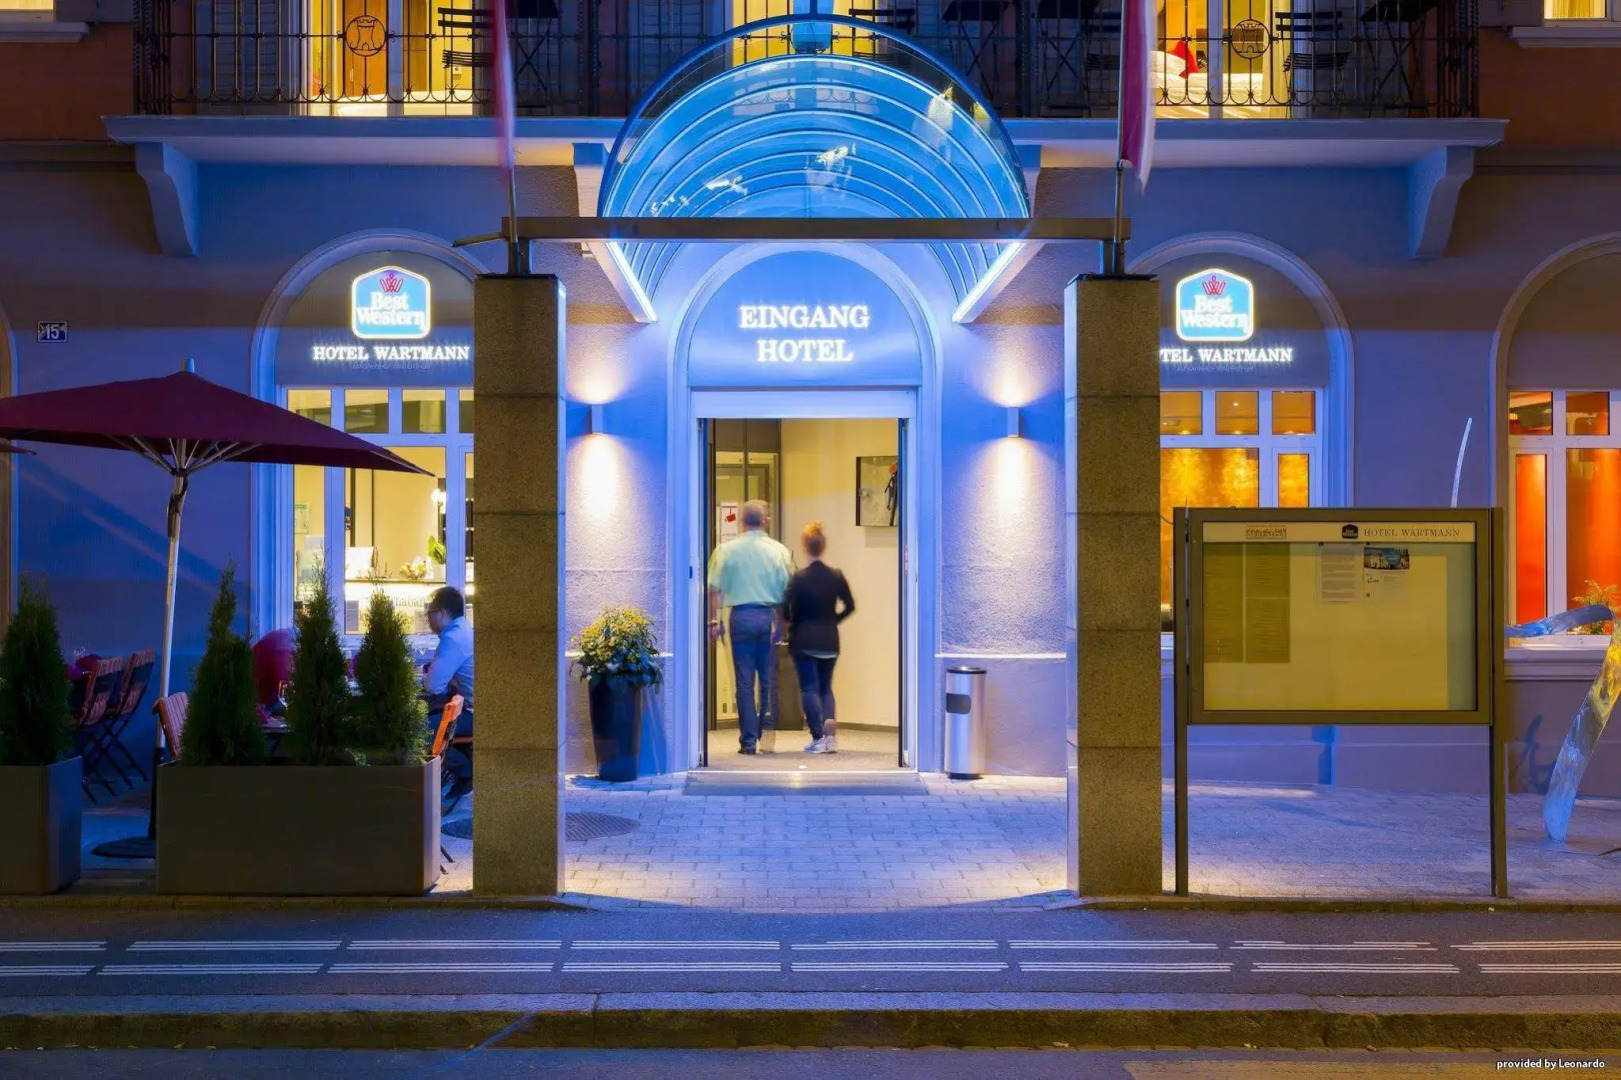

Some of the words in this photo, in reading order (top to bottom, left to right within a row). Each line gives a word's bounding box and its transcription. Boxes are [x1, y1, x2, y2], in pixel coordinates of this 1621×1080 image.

[371, 292, 409, 309] Best
[1194, 295, 1233, 313] Best
[356, 307, 426, 331] Western
[739, 305, 870, 328] EINGANG
[1180, 310, 1249, 333] Western
[46, 323, 60, 339] 15
[312, 346, 369, 360] HOTEL
[373, 346, 470, 360] WARTMANN
[757, 339, 854, 362] HOTEL
[1160, 349, 1193, 362] TEL
[1198, 349, 1293, 362] WARTMANN
[1364, 528, 1398, 537] HOTEL
[1401, 528, 1460, 537] WARTMANN
